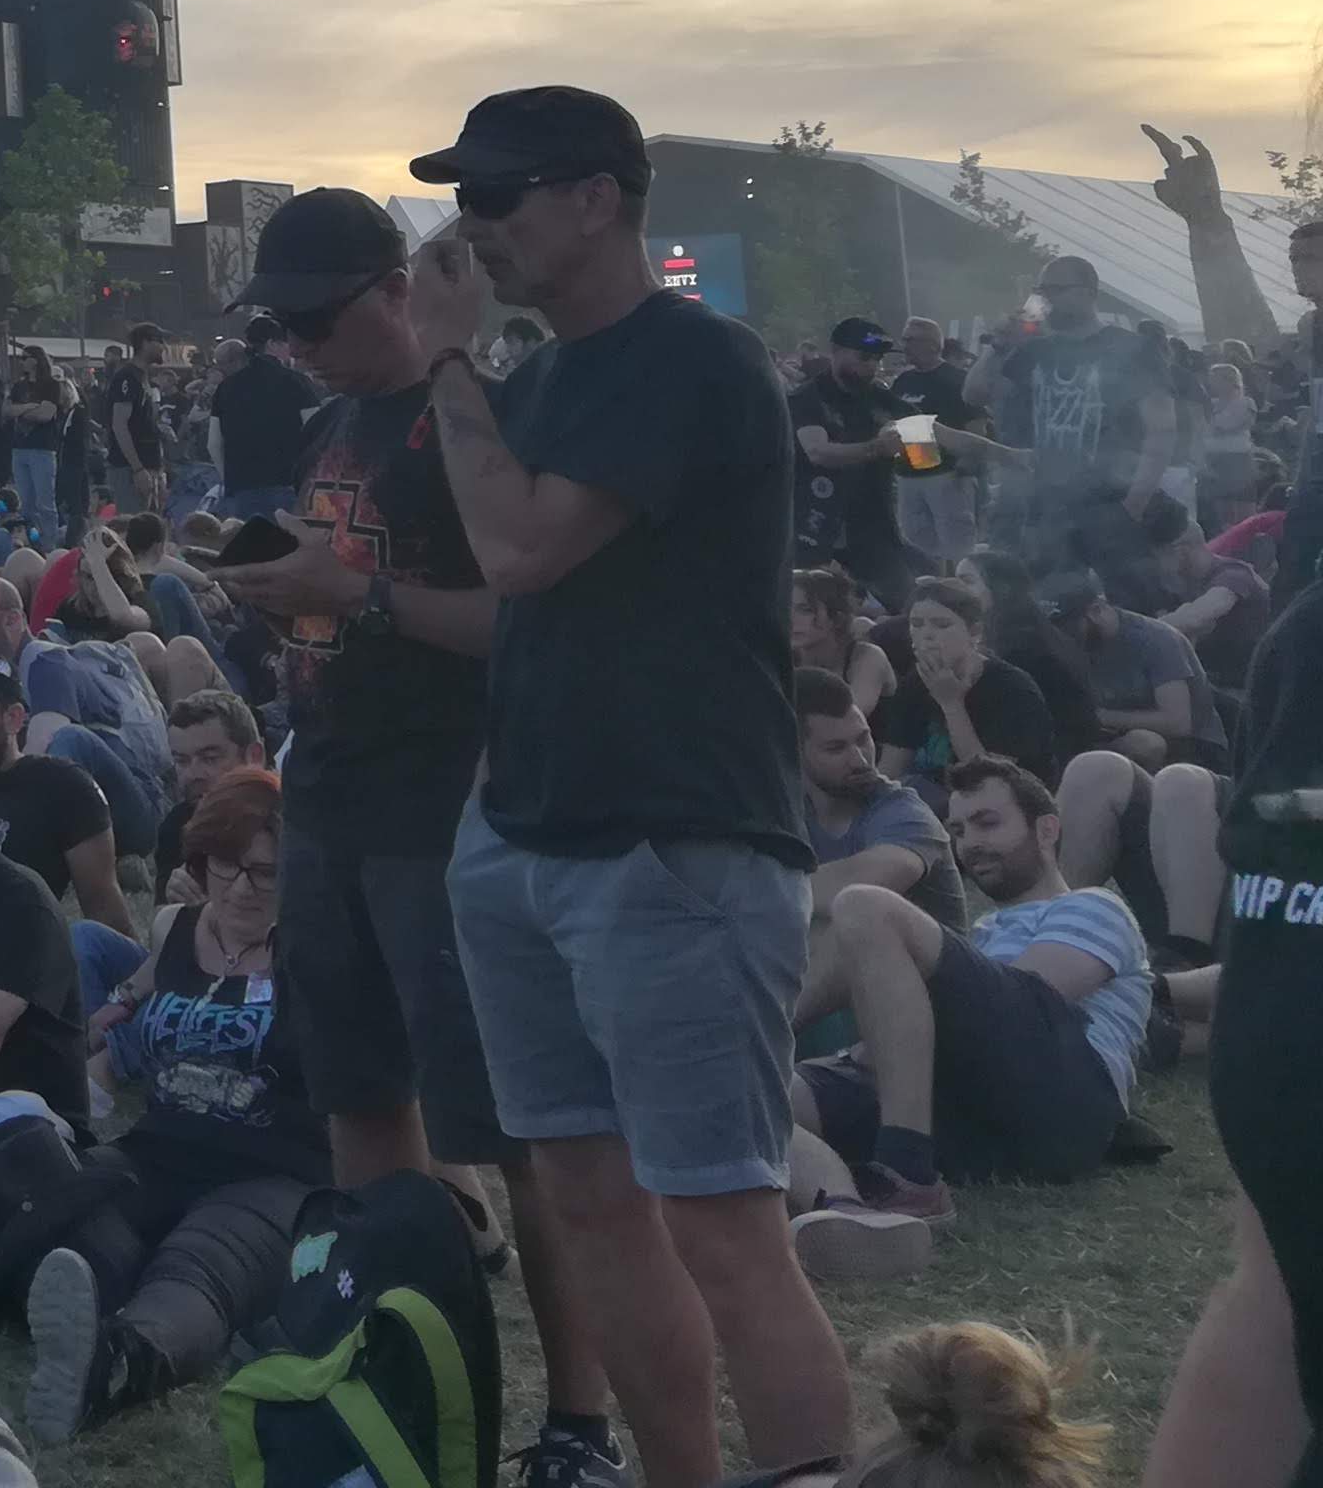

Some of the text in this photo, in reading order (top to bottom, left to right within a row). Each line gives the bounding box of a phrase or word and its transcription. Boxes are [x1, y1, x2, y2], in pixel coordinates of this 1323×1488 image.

[663, 274, 697, 287] ENVY
[1233, 873, 1285, 920] VIP
[141, 991, 275, 1060] HELLFEST
